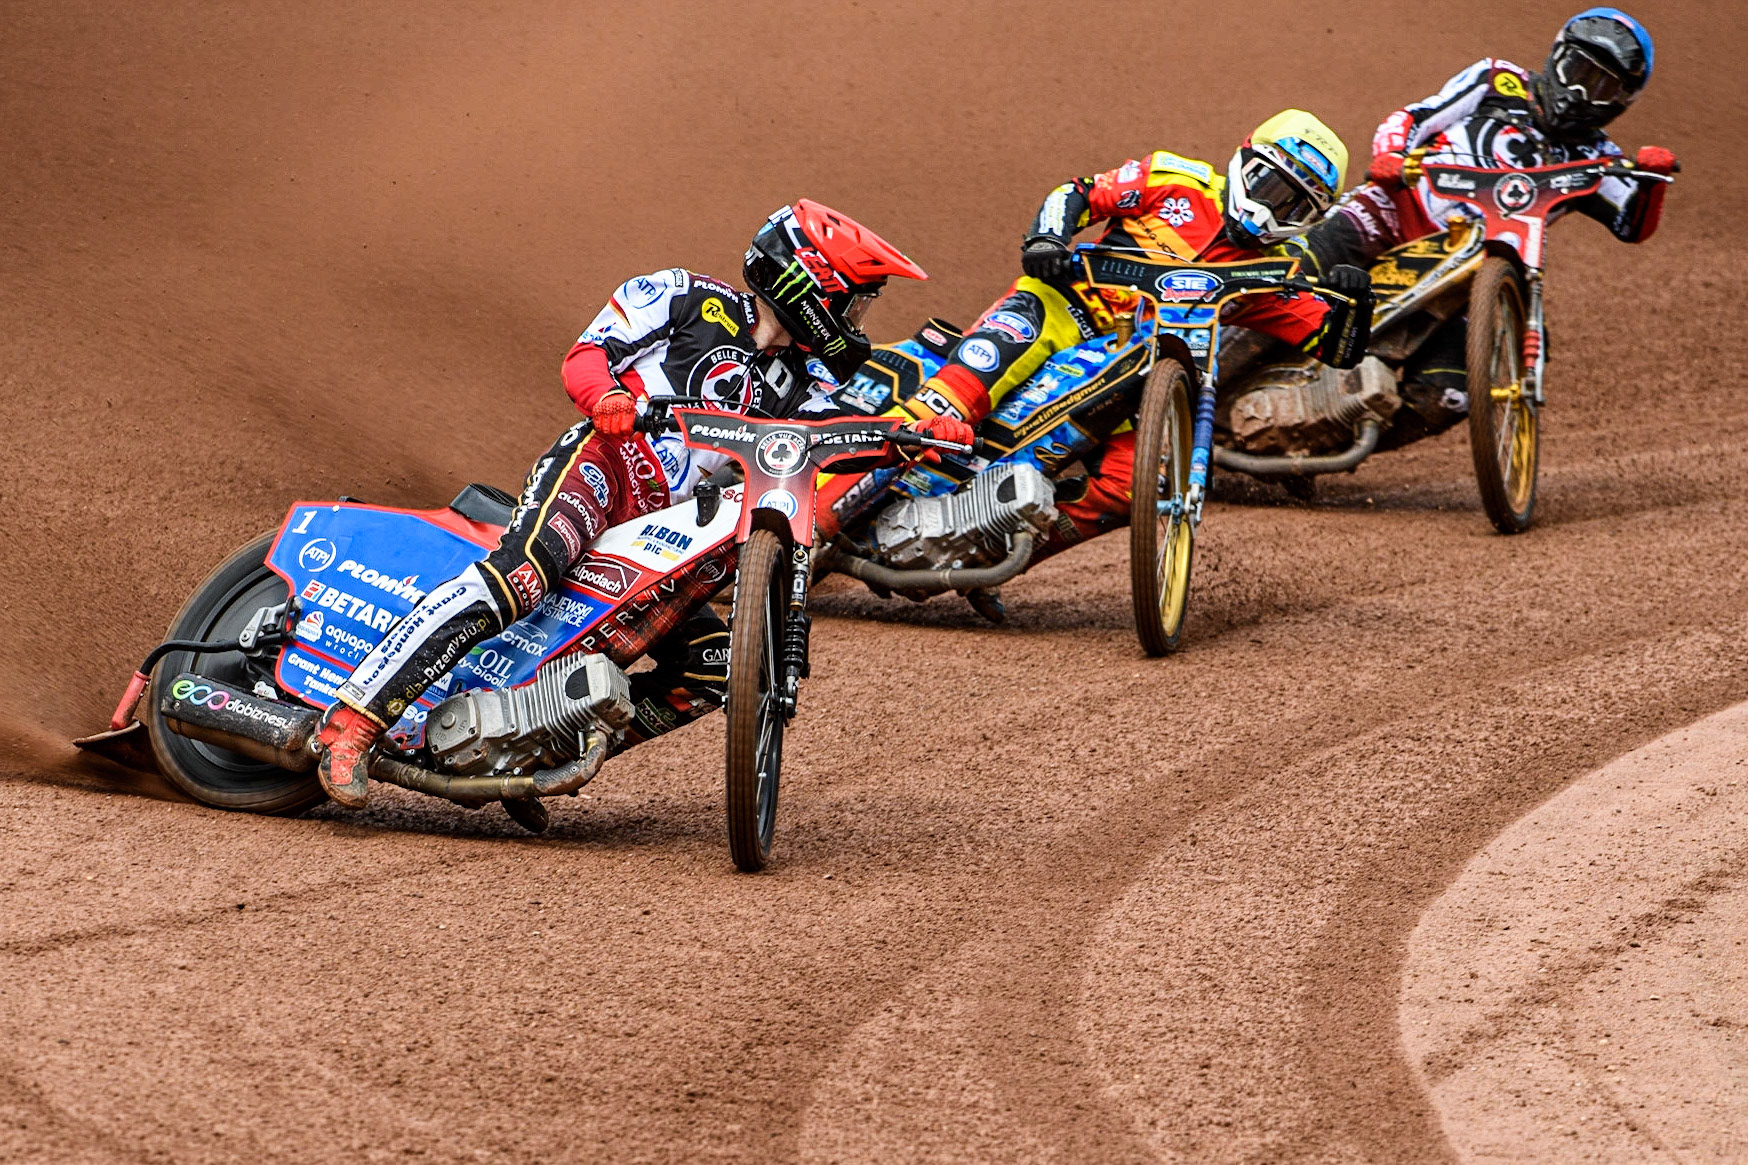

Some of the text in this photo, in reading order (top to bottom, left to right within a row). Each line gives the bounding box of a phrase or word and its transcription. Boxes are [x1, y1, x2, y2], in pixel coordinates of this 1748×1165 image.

[800, 300, 832, 340] MONSTER
[710, 350, 738, 365] BELLE
[967, 344, 992, 362] ATPI
[760, 435, 777, 450] BELLE
[292, 510, 317, 534] 1
[640, 524, 693, 551] ALBON
[305, 546, 330, 564] ATPI
[570, 565, 622, 594] Alpodach
[362, 586, 467, 685] Grant Henderson
[288, 653, 321, 675] Grant
[479, 649, 515, 679] OIL
[225, 699, 293, 729] dlabiznesu
